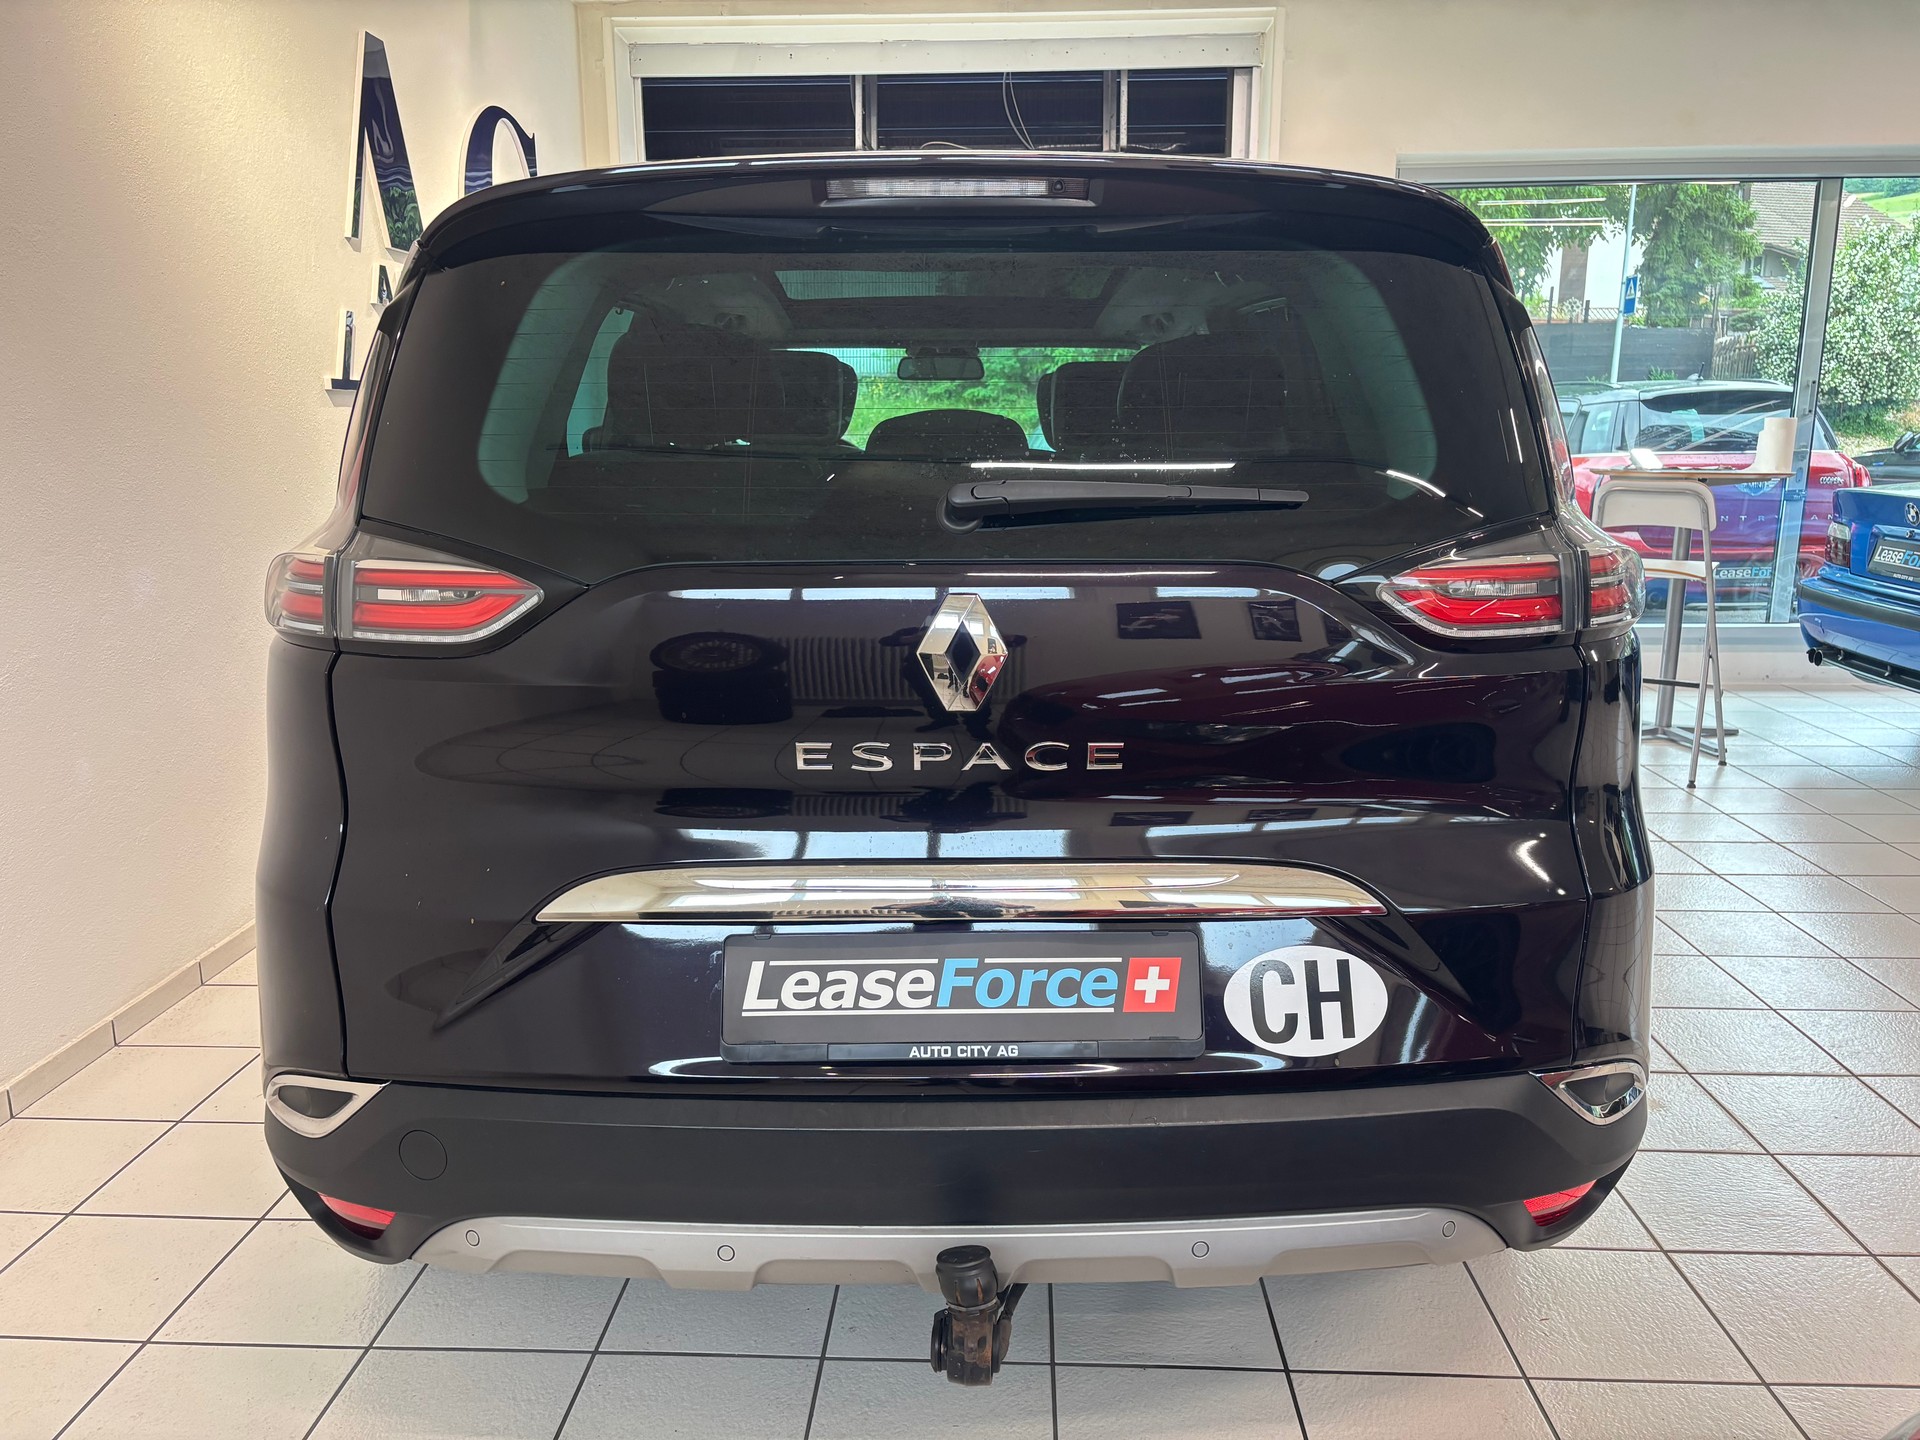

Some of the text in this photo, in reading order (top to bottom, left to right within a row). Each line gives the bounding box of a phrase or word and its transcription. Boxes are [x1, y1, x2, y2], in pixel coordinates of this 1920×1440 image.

[1875, 546, 1920, 568] LeaseFo
[1713, 567, 1772, 578] LeaseFor
[795, 741, 1126, 771] ESPACE
[742, 958, 1119, 1010] LeaseForce
[1249, 958, 1356, 1044] CH
[908, 1044, 1019, 1058] AUTO CITY AG
